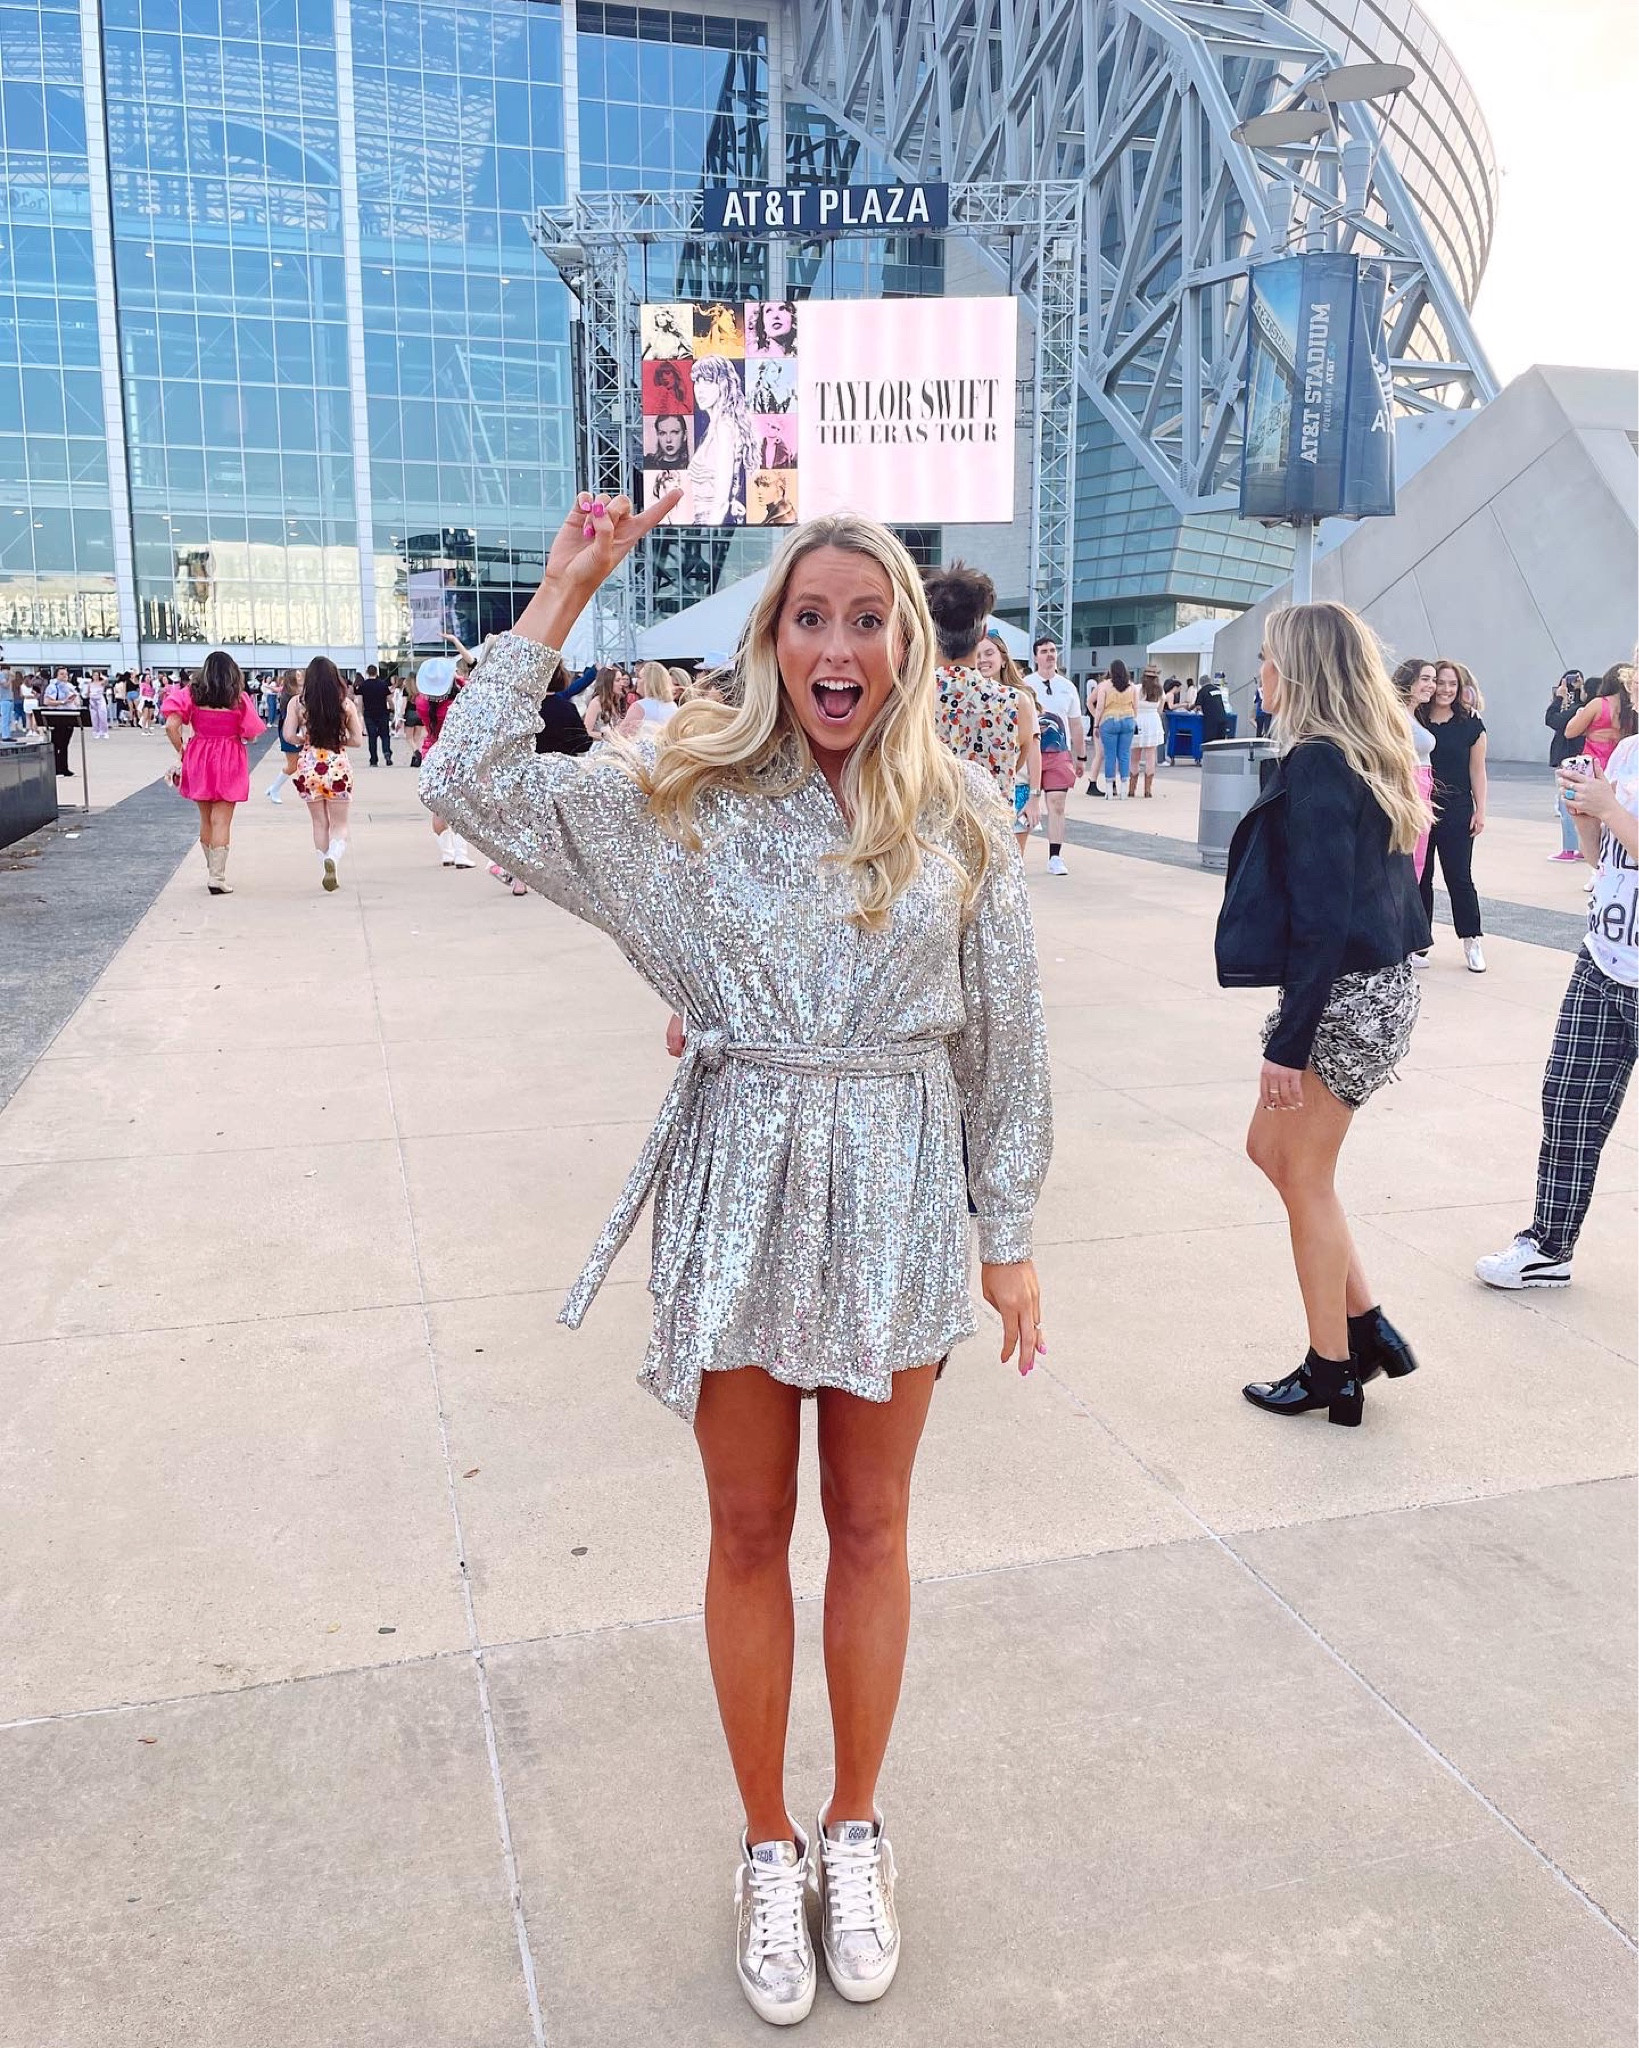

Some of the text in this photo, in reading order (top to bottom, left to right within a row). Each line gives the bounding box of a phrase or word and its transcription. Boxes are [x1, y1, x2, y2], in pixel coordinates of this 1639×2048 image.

[722, 187, 929, 227] AT&T PLAZA
[1300, 303, 1331, 464] AT&T STADIUM
[1325, 358, 1335, 384] AT&T
[815, 379, 999, 421] TAYLOR SWIFT
[816, 422, 997, 444] THE ERAS TOUR
